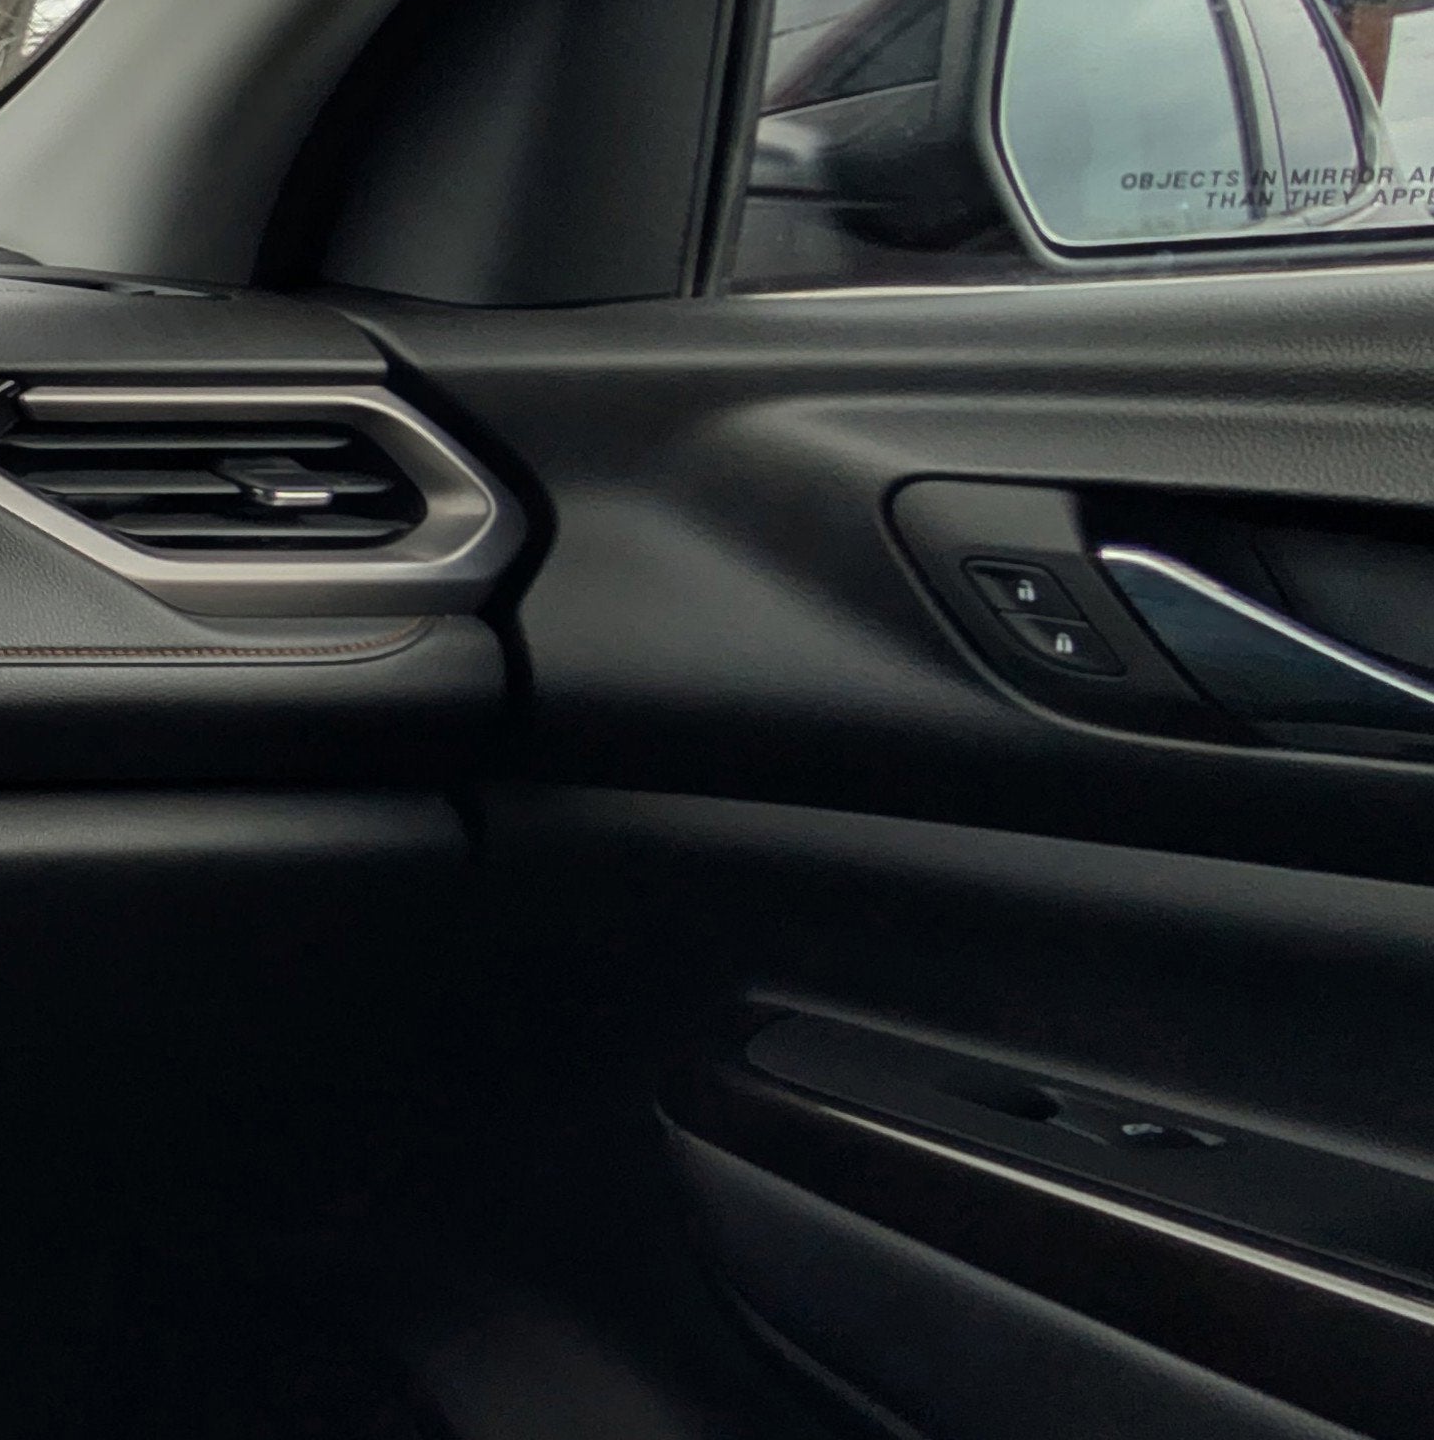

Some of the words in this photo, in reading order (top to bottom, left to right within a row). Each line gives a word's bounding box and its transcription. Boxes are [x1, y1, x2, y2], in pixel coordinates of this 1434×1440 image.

[1120, 170, 1239, 191] OBJECTS
[1250, 169, 1277, 186] IN
[1290, 167, 1393, 185] MIRROR
[1206, 190, 1272, 208] THAN
[1290, 189, 1352, 206] THEY
